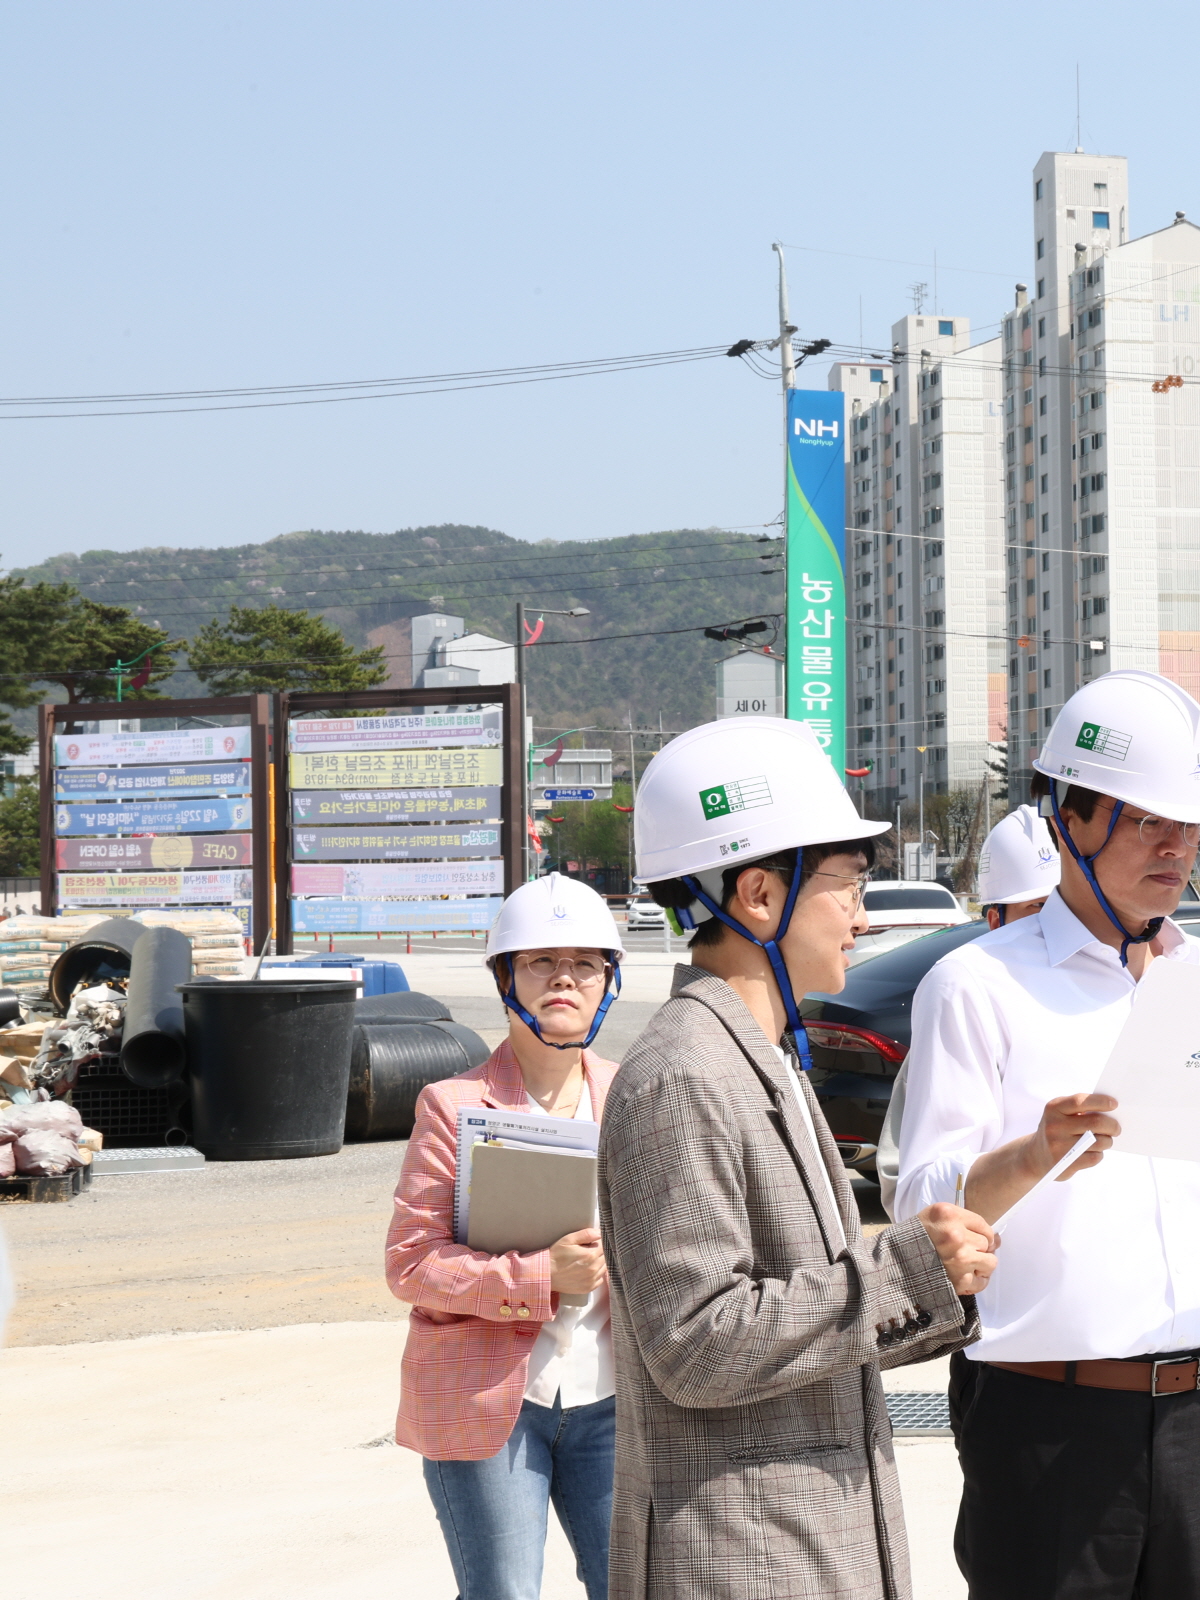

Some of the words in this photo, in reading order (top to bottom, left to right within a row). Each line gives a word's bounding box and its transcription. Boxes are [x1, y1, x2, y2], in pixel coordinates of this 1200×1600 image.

[1159, 304, 1189, 322] LH
[794, 418, 839, 438] NH
[799, 437, 834, 447] NongHyup
[799, 572, 835, 764] 농산물유통
[734, 699, 767, 712] 세아
